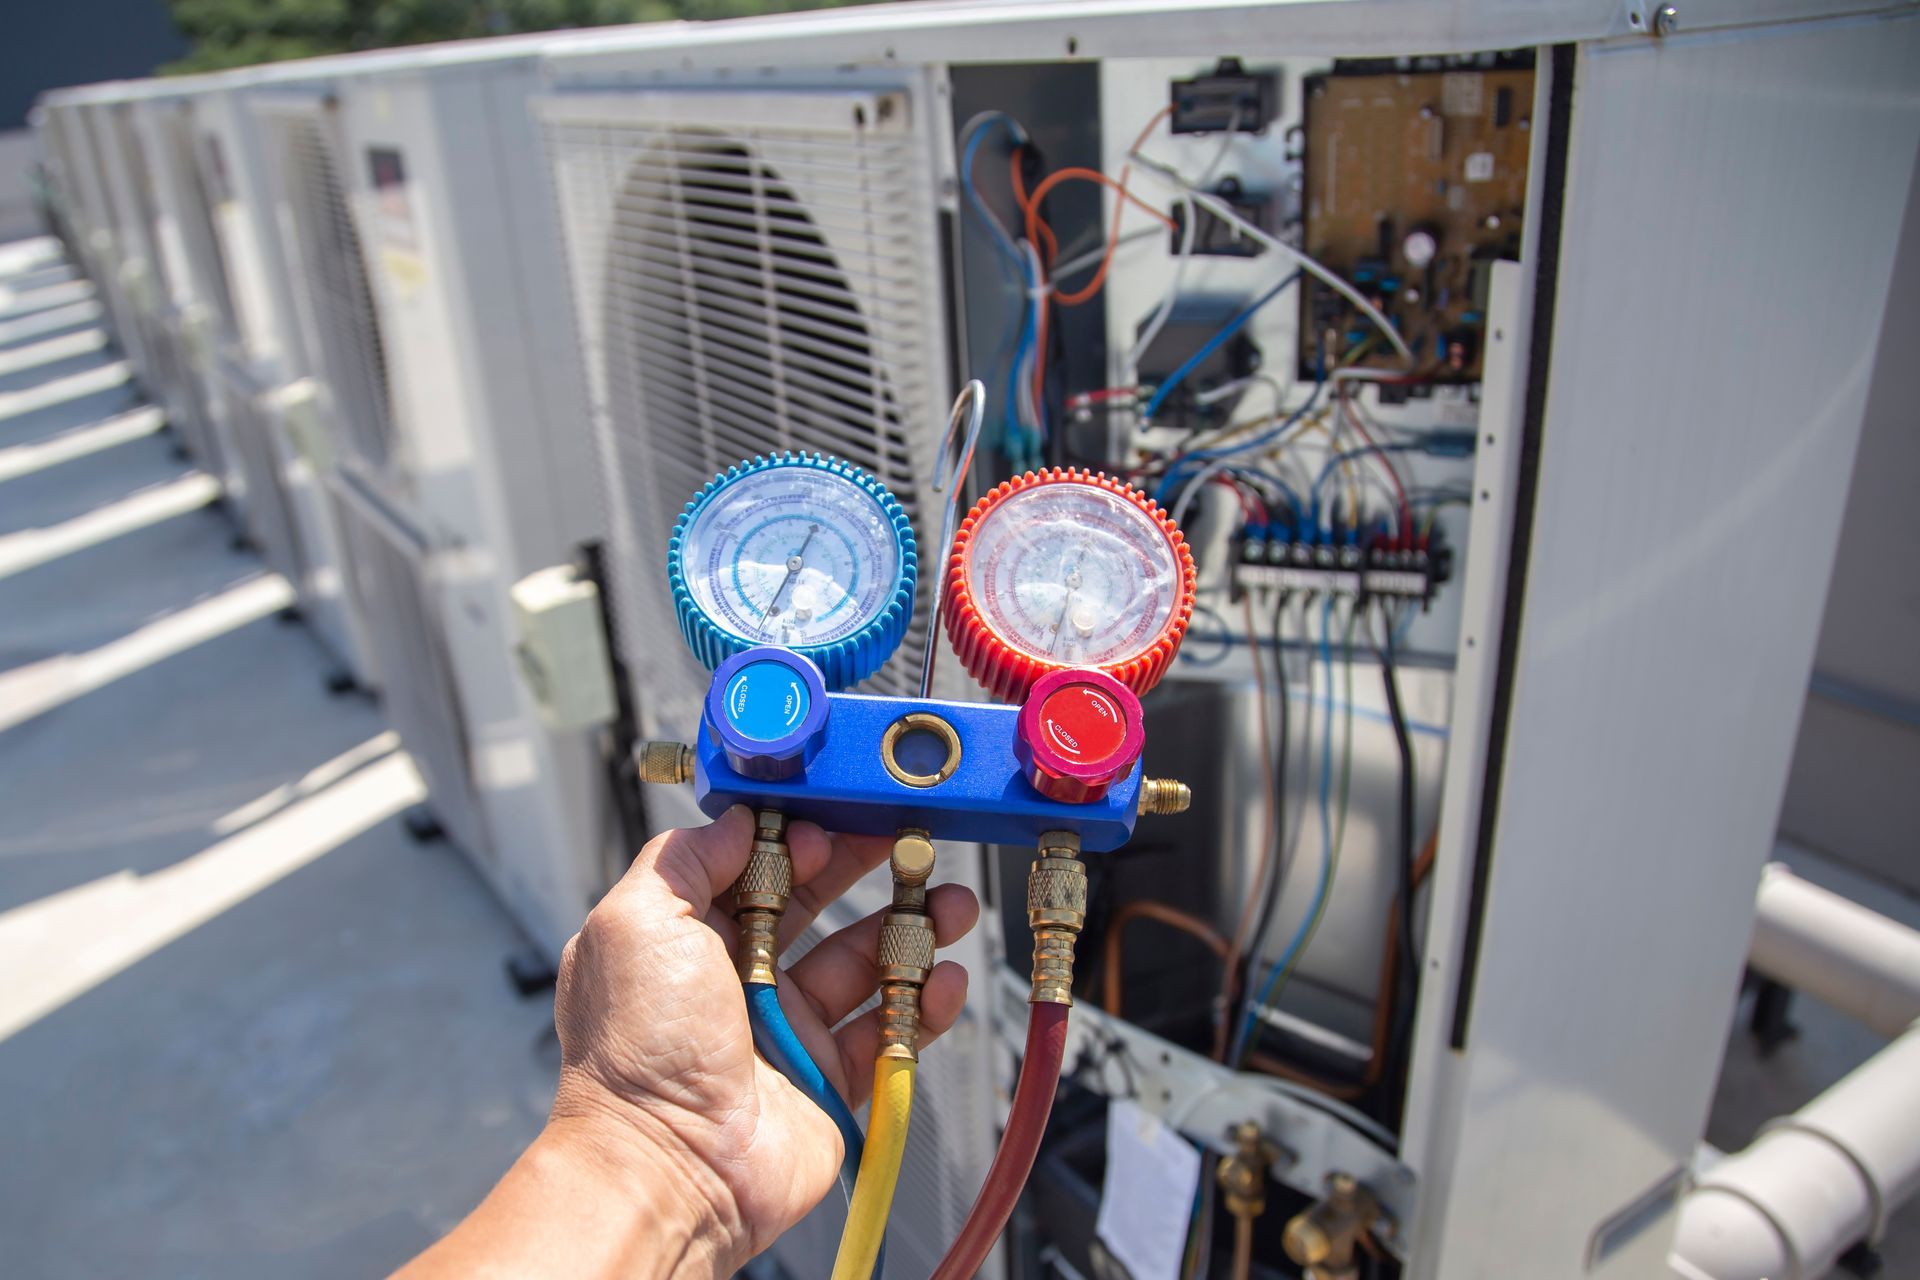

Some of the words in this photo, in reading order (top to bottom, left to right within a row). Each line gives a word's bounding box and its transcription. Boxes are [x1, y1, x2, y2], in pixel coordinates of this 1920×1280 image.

[738, 684, 748, 713] CLOSED
[784, 694, 792, 715] OPEN
[1091, 700, 1108, 717] OPEN
[1055, 724, 1078, 748] CLOSED
